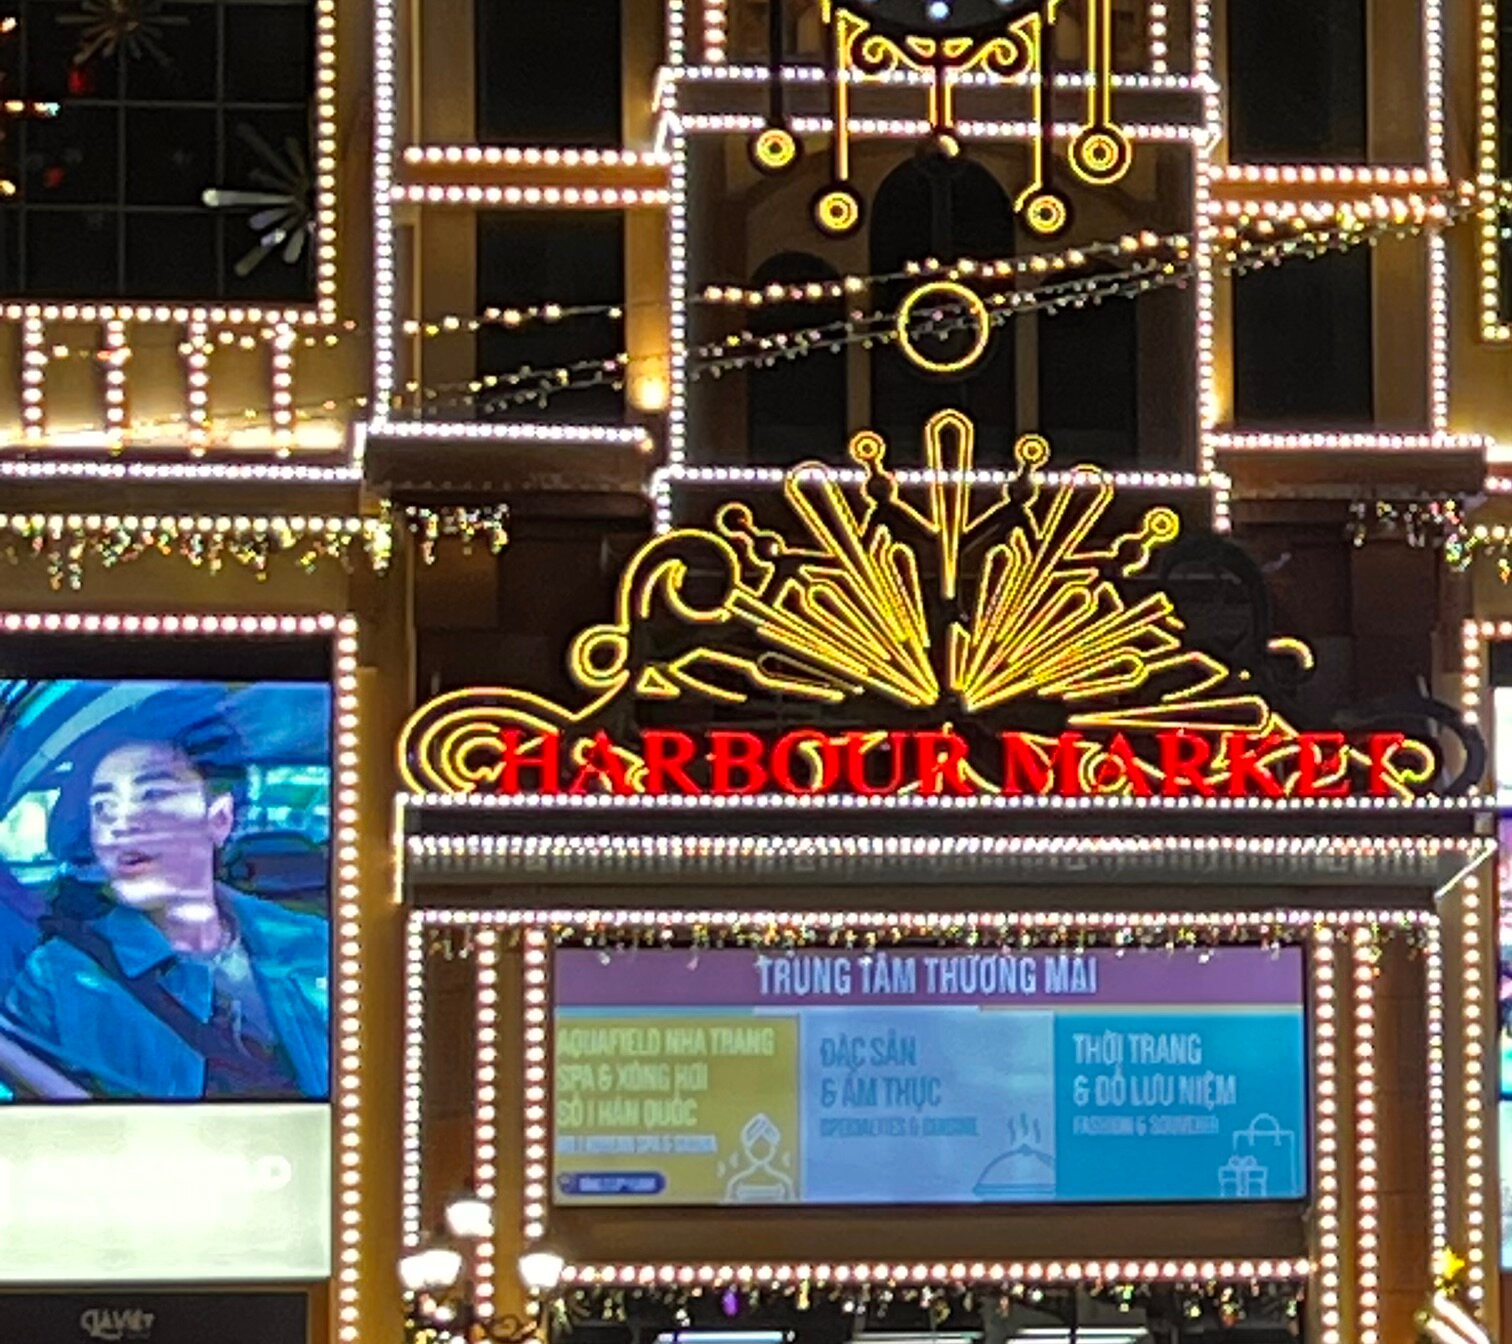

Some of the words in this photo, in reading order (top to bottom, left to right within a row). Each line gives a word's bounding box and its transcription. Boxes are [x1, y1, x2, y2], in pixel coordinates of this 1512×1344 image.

[499, 729, 978, 795] HARBOUR
[1001, 731, 1405, 795] MARKET
[758, 955, 851, 995] TRUNG
[861, 952, 916, 994] TÂM
[558, 1028, 660, 1057] AQUAFIELD
[665, 1028, 708, 1056] NHA
[710, 1027, 775, 1056] TRANG
[1128, 1032, 1202, 1065] TRANG
[558, 1064, 595, 1092] SPA
[820, 1077, 836, 1108] &
[1073, 1075, 1089, 1107] &
